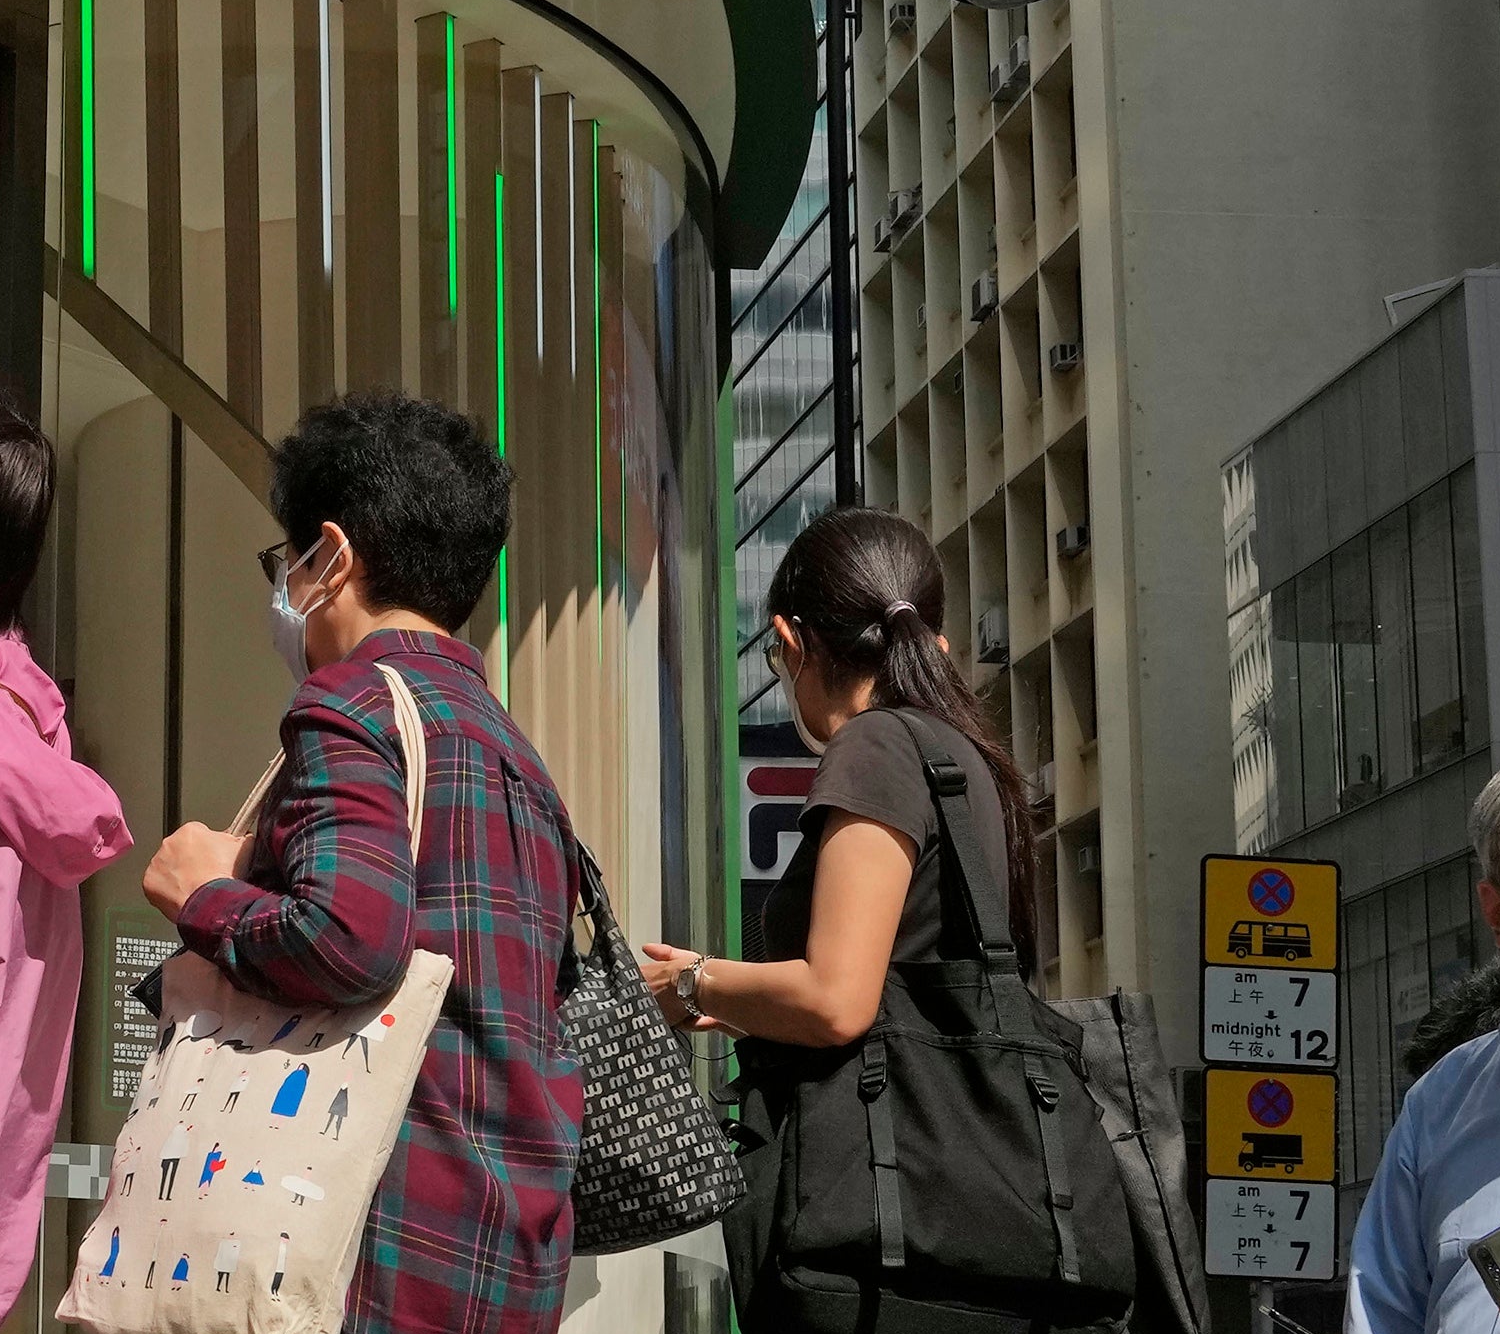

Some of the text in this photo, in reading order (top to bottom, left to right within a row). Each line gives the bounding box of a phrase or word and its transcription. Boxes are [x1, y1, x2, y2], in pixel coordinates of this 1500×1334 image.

[1228, 989, 1264, 1004] 上午
[1235, 973, 1310, 1007] am 7
[1211, 1022, 1329, 1060] midnight 12
[1228, 1040, 1264, 1057] 午夜
[1231, 1203, 1267, 1217] 上午
[1238, 1187, 1310, 1220] am 7
[1232, 1253, 1267, 1269] 下午
[1238, 1237, 1310, 1271] pm 7
